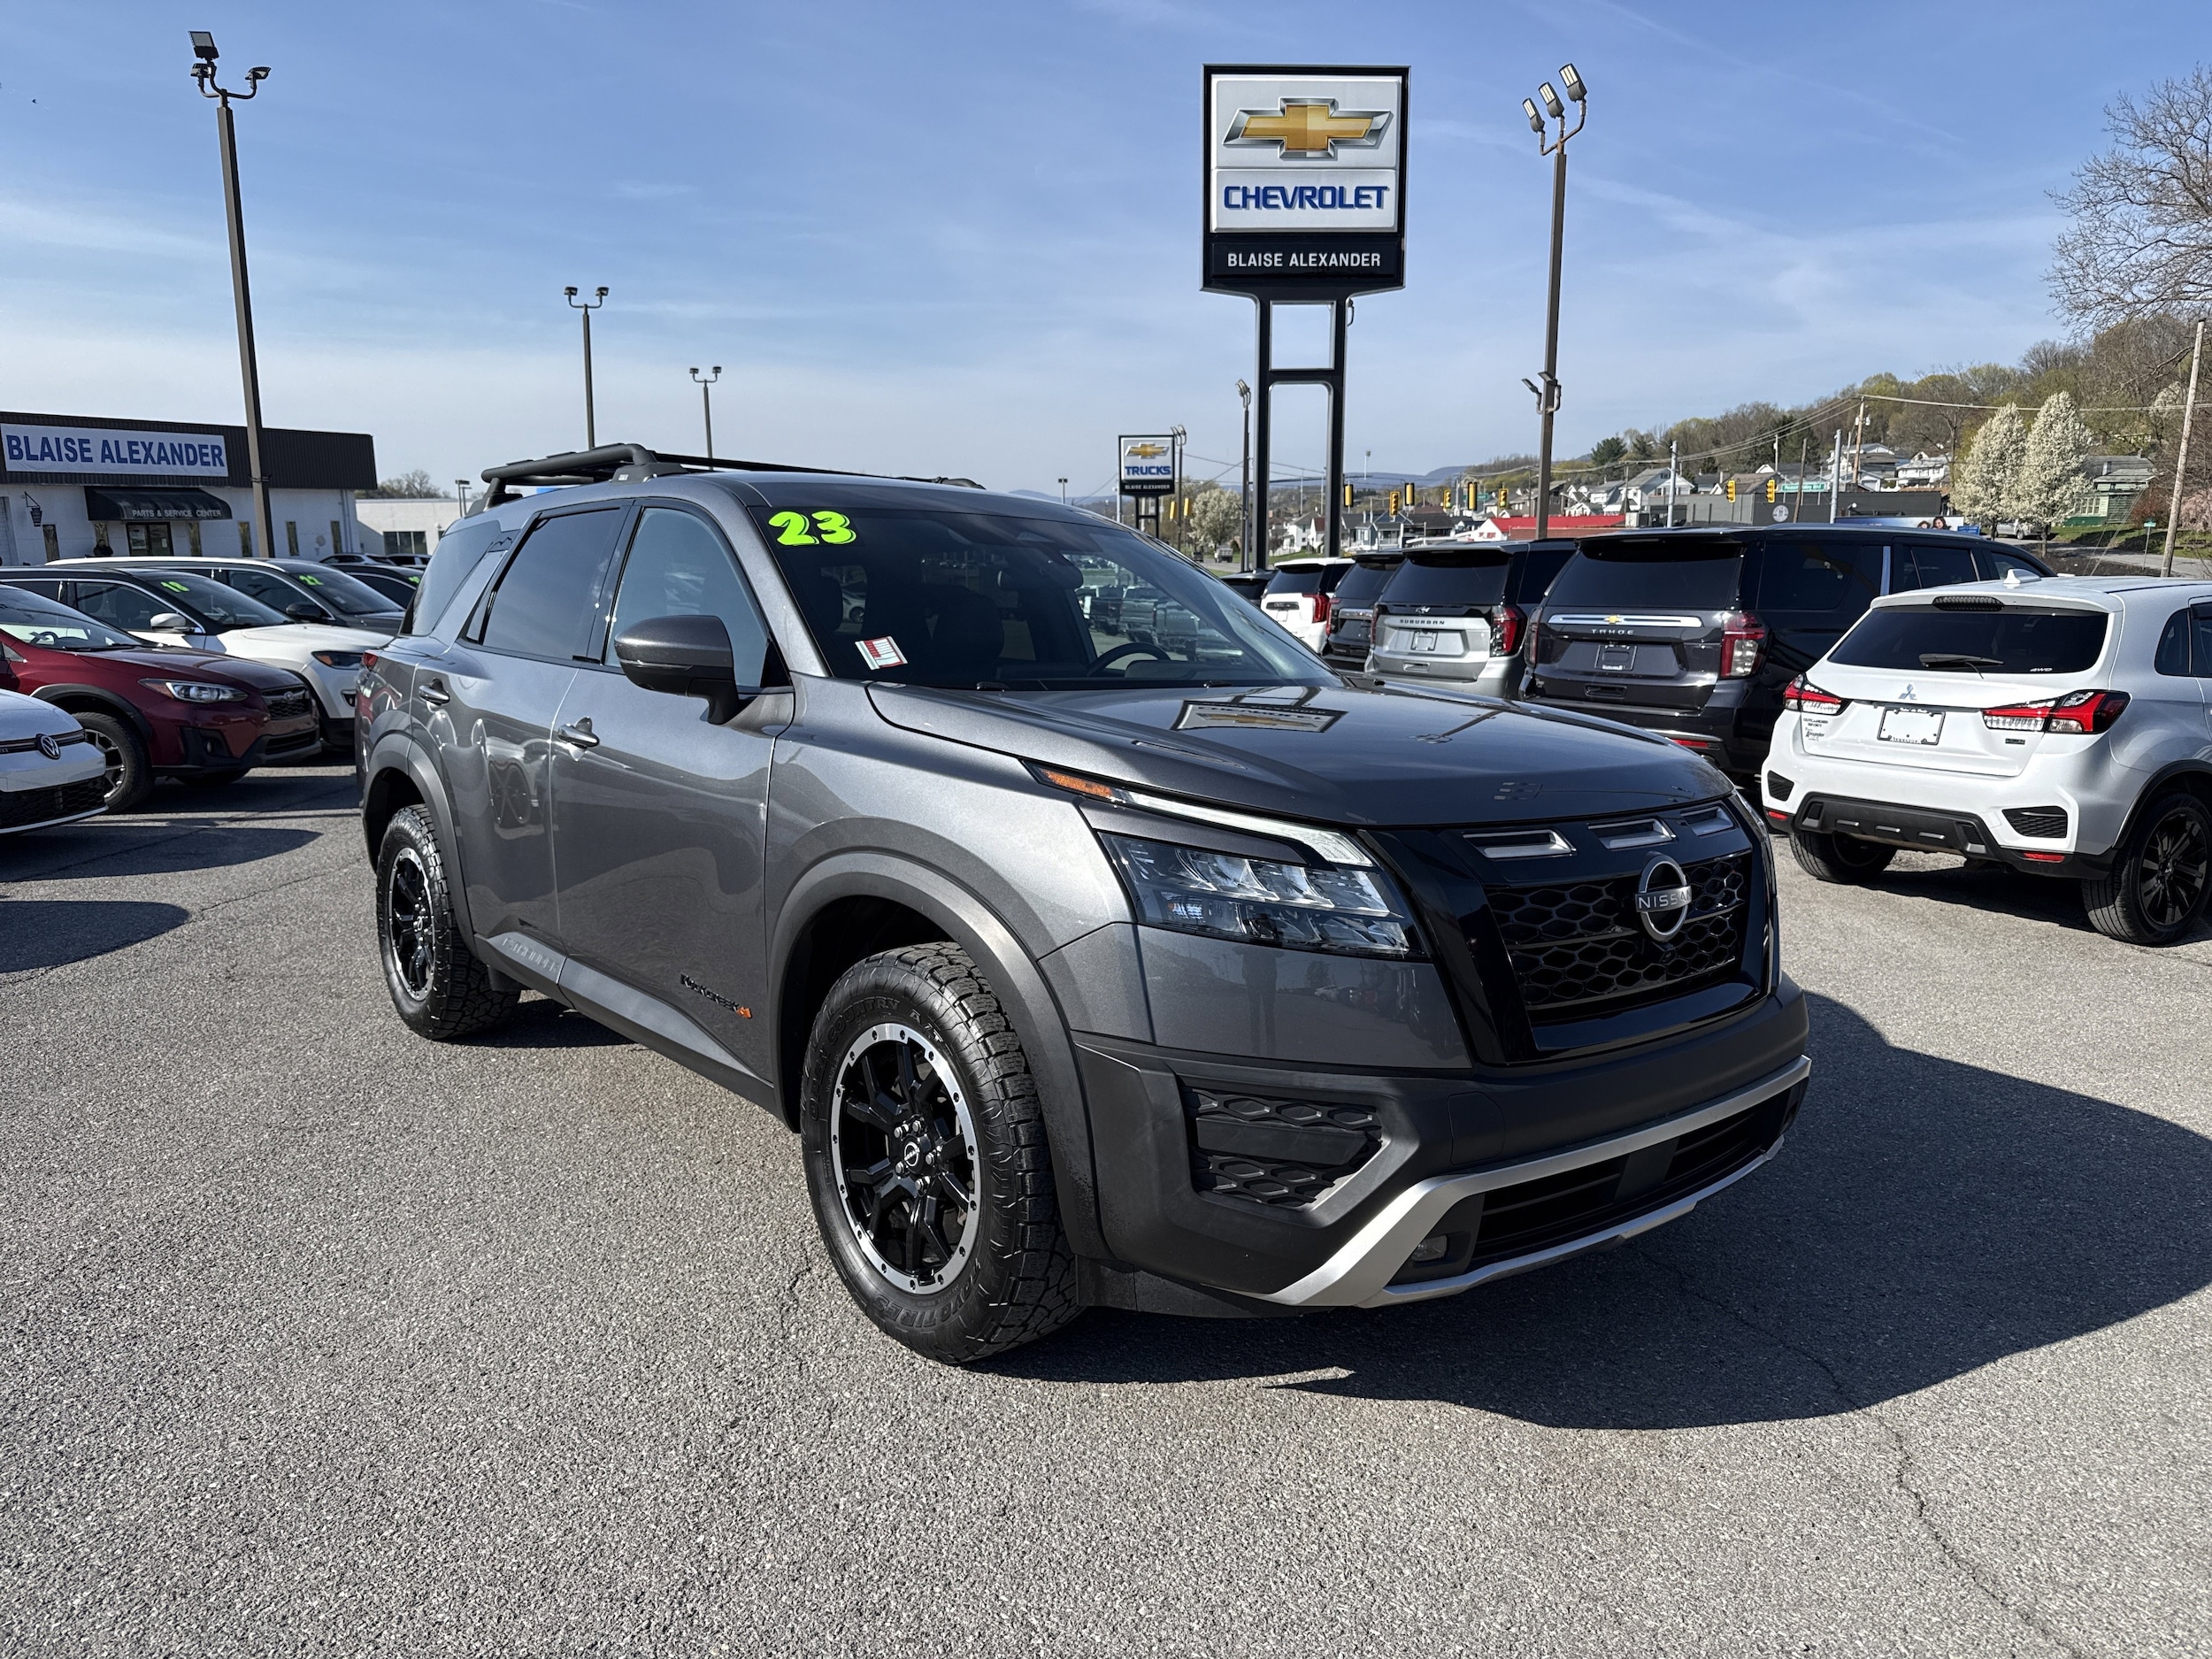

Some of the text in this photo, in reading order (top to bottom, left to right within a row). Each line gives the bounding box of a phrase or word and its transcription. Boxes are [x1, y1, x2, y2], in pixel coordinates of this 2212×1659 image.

[1225, 186, 1389, 209] CHEVROLET
[1227, 253, 1381, 267] BLAISE ALEXANDER
[6, 434, 225, 467] BLAISE ALEXANDER
[1125, 465, 1171, 475] TRUCKS
[768, 511, 856, 546] 23
[1638, 890, 1689, 909] NISSAN
[827, 995, 901, 1046] COUNTRY
